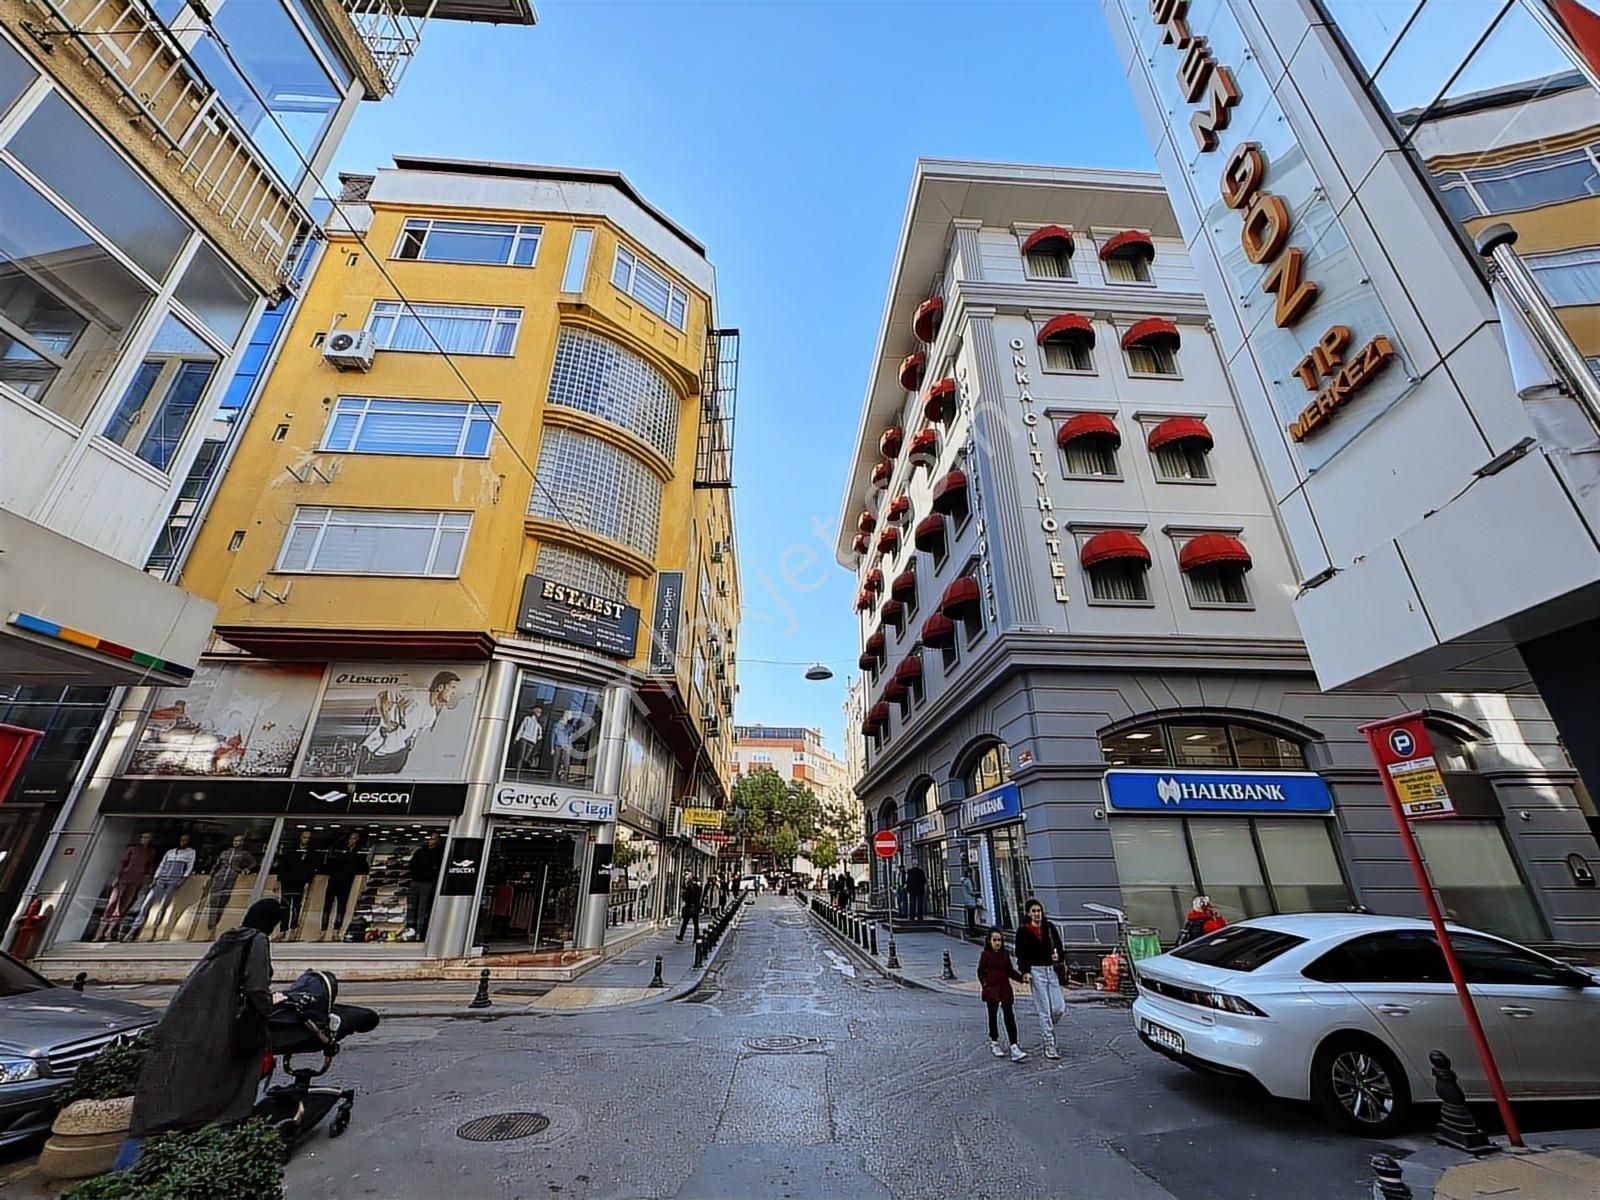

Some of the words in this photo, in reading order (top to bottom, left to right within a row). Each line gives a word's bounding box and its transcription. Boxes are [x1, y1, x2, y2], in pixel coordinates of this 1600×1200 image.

[1219, 142, 1319, 328] GÖZ
[1009, 336, 1034, 403] ONKA
[1023, 412, 1049, 487] CITY
[1037, 496, 1071, 603] HOTEL
[658, 587, 674, 663] ESTAEST
[1394, 735, 1410, 751] P
[497, 787, 559, 809] Gerçek
[568, 799, 613, 820] Çizgi
[1183, 783, 1286, 801] HALKBANK
